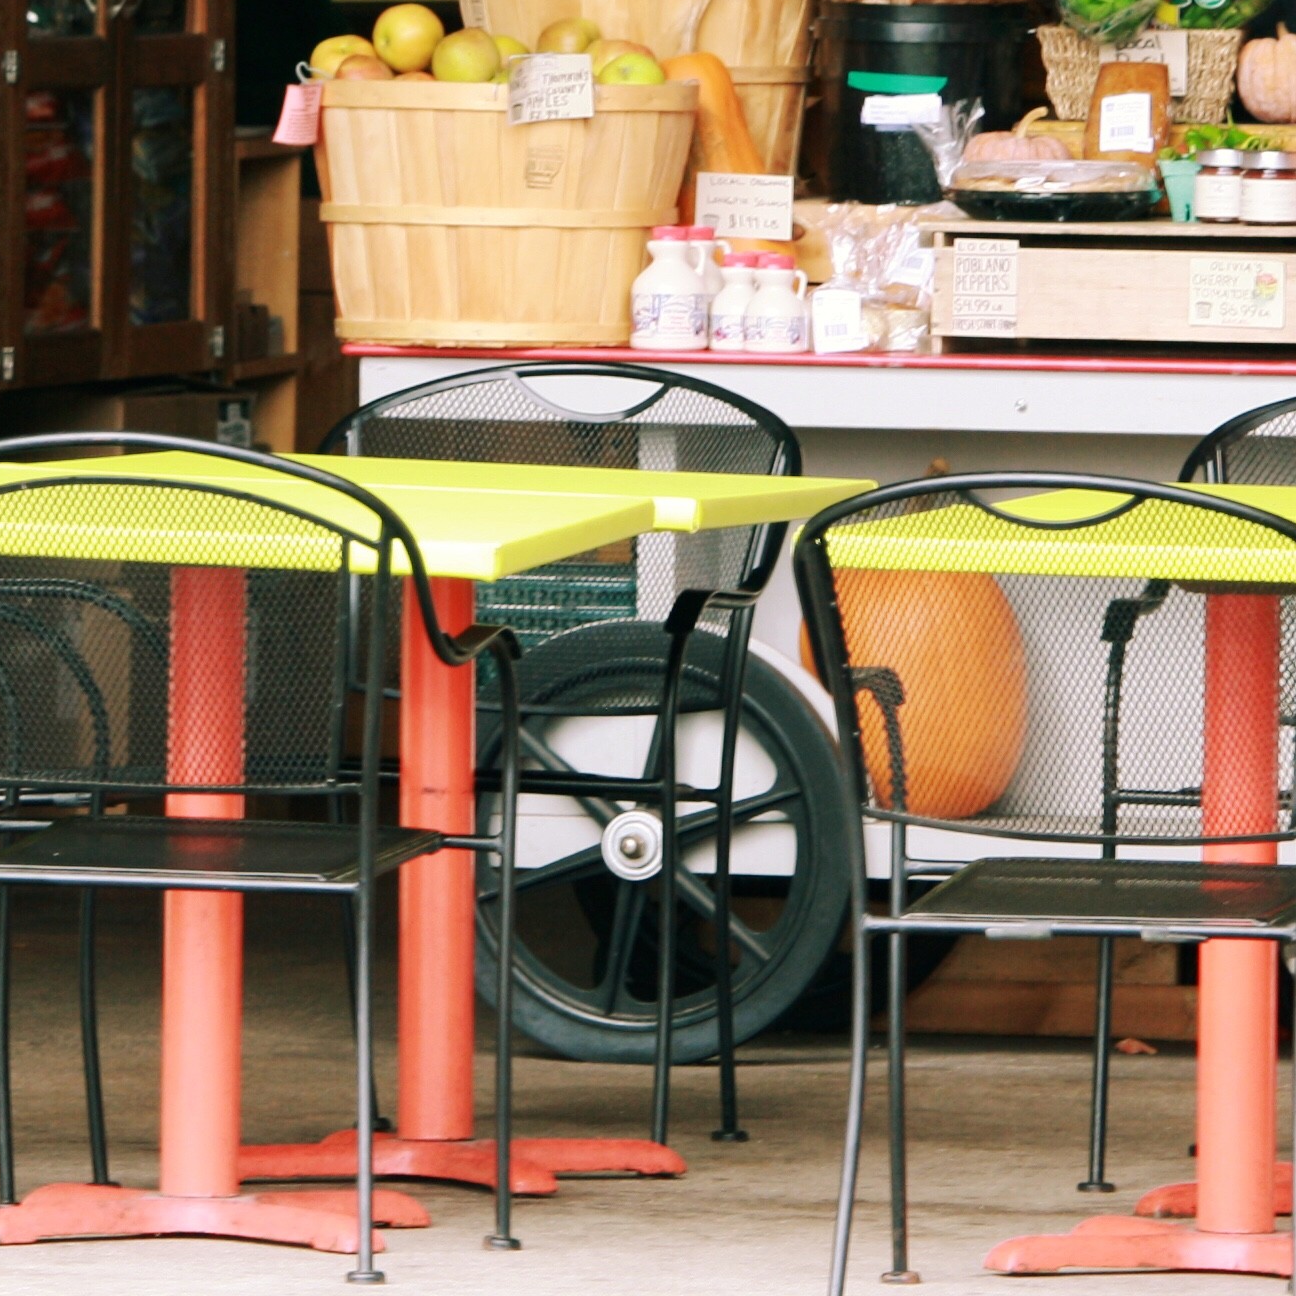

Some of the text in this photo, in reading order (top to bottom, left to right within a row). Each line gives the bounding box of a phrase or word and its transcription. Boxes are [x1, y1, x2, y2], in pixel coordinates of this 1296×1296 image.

[956, 242, 1008, 252] LOCAL
[955, 257, 1010, 273] POBLANO
[954, 274, 1009, 292] PEPPERS
[1191, 273, 1239, 286] CHERRY
